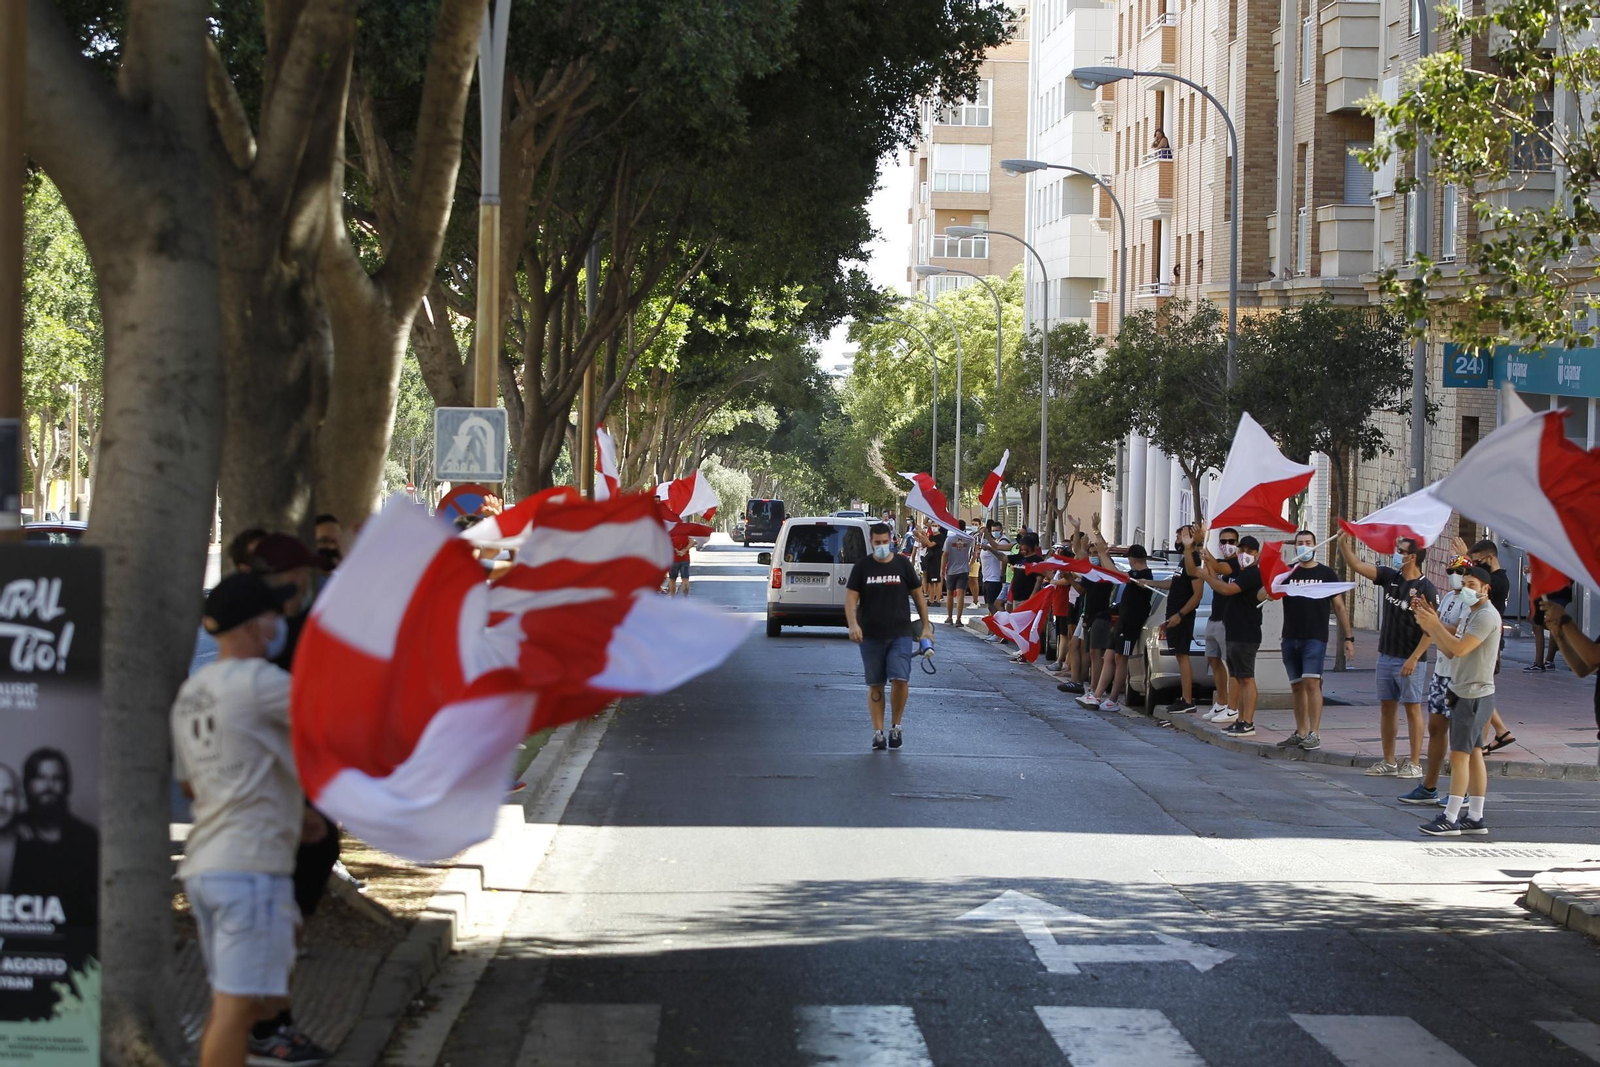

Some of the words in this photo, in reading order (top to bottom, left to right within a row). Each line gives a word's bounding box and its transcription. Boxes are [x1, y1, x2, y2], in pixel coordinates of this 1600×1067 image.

[0, 577, 66, 622] RAL
[0, 893, 67, 924] ECIA
[2, 957, 68, 975] AGOSTO
[0, 976, 34, 991] YRAN
